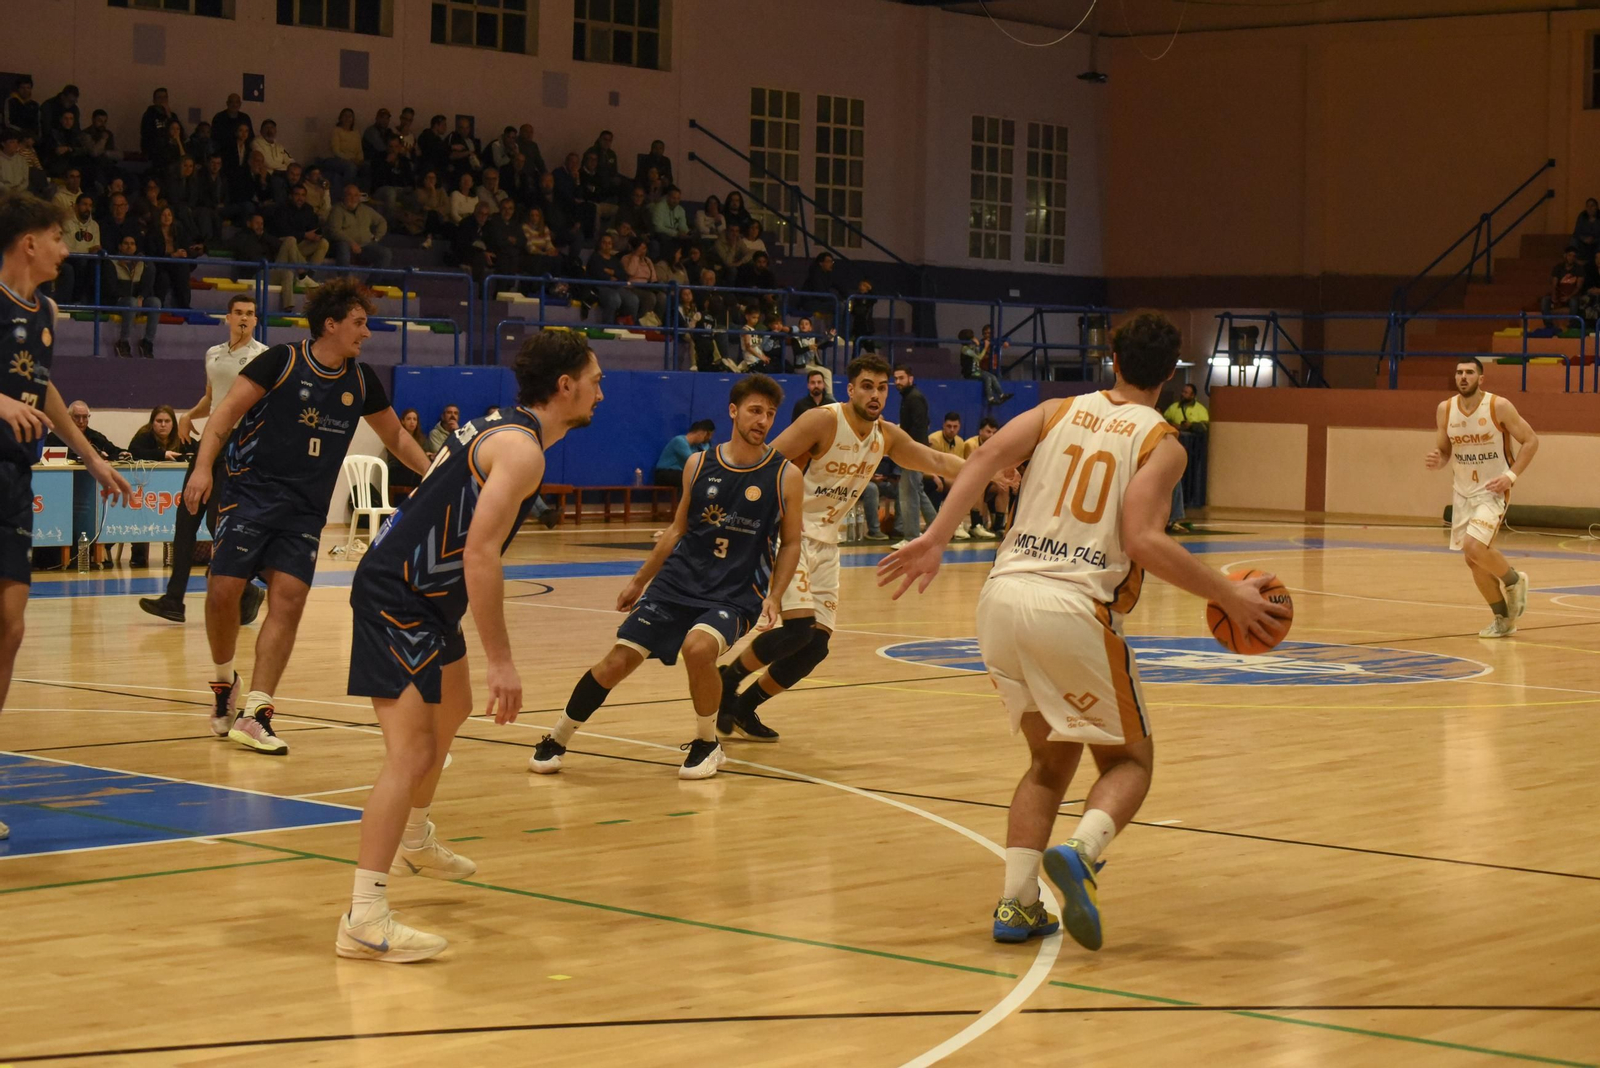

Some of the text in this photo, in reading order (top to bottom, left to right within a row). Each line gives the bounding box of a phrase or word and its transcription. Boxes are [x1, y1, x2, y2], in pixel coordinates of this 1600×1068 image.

[1071, 409, 1137, 437] EDU GEA
[308, 437, 321, 457] 0
[1478, 451, 1499, 461] OLEA
[1053, 444, 1117, 524] 10
[1471, 470, 1479, 483] 4
[713, 537, 729, 559] 3
[1011, 548, 1077, 564] INOBILIAA
[1014, 533, 1106, 569] MOLINA OLEA
